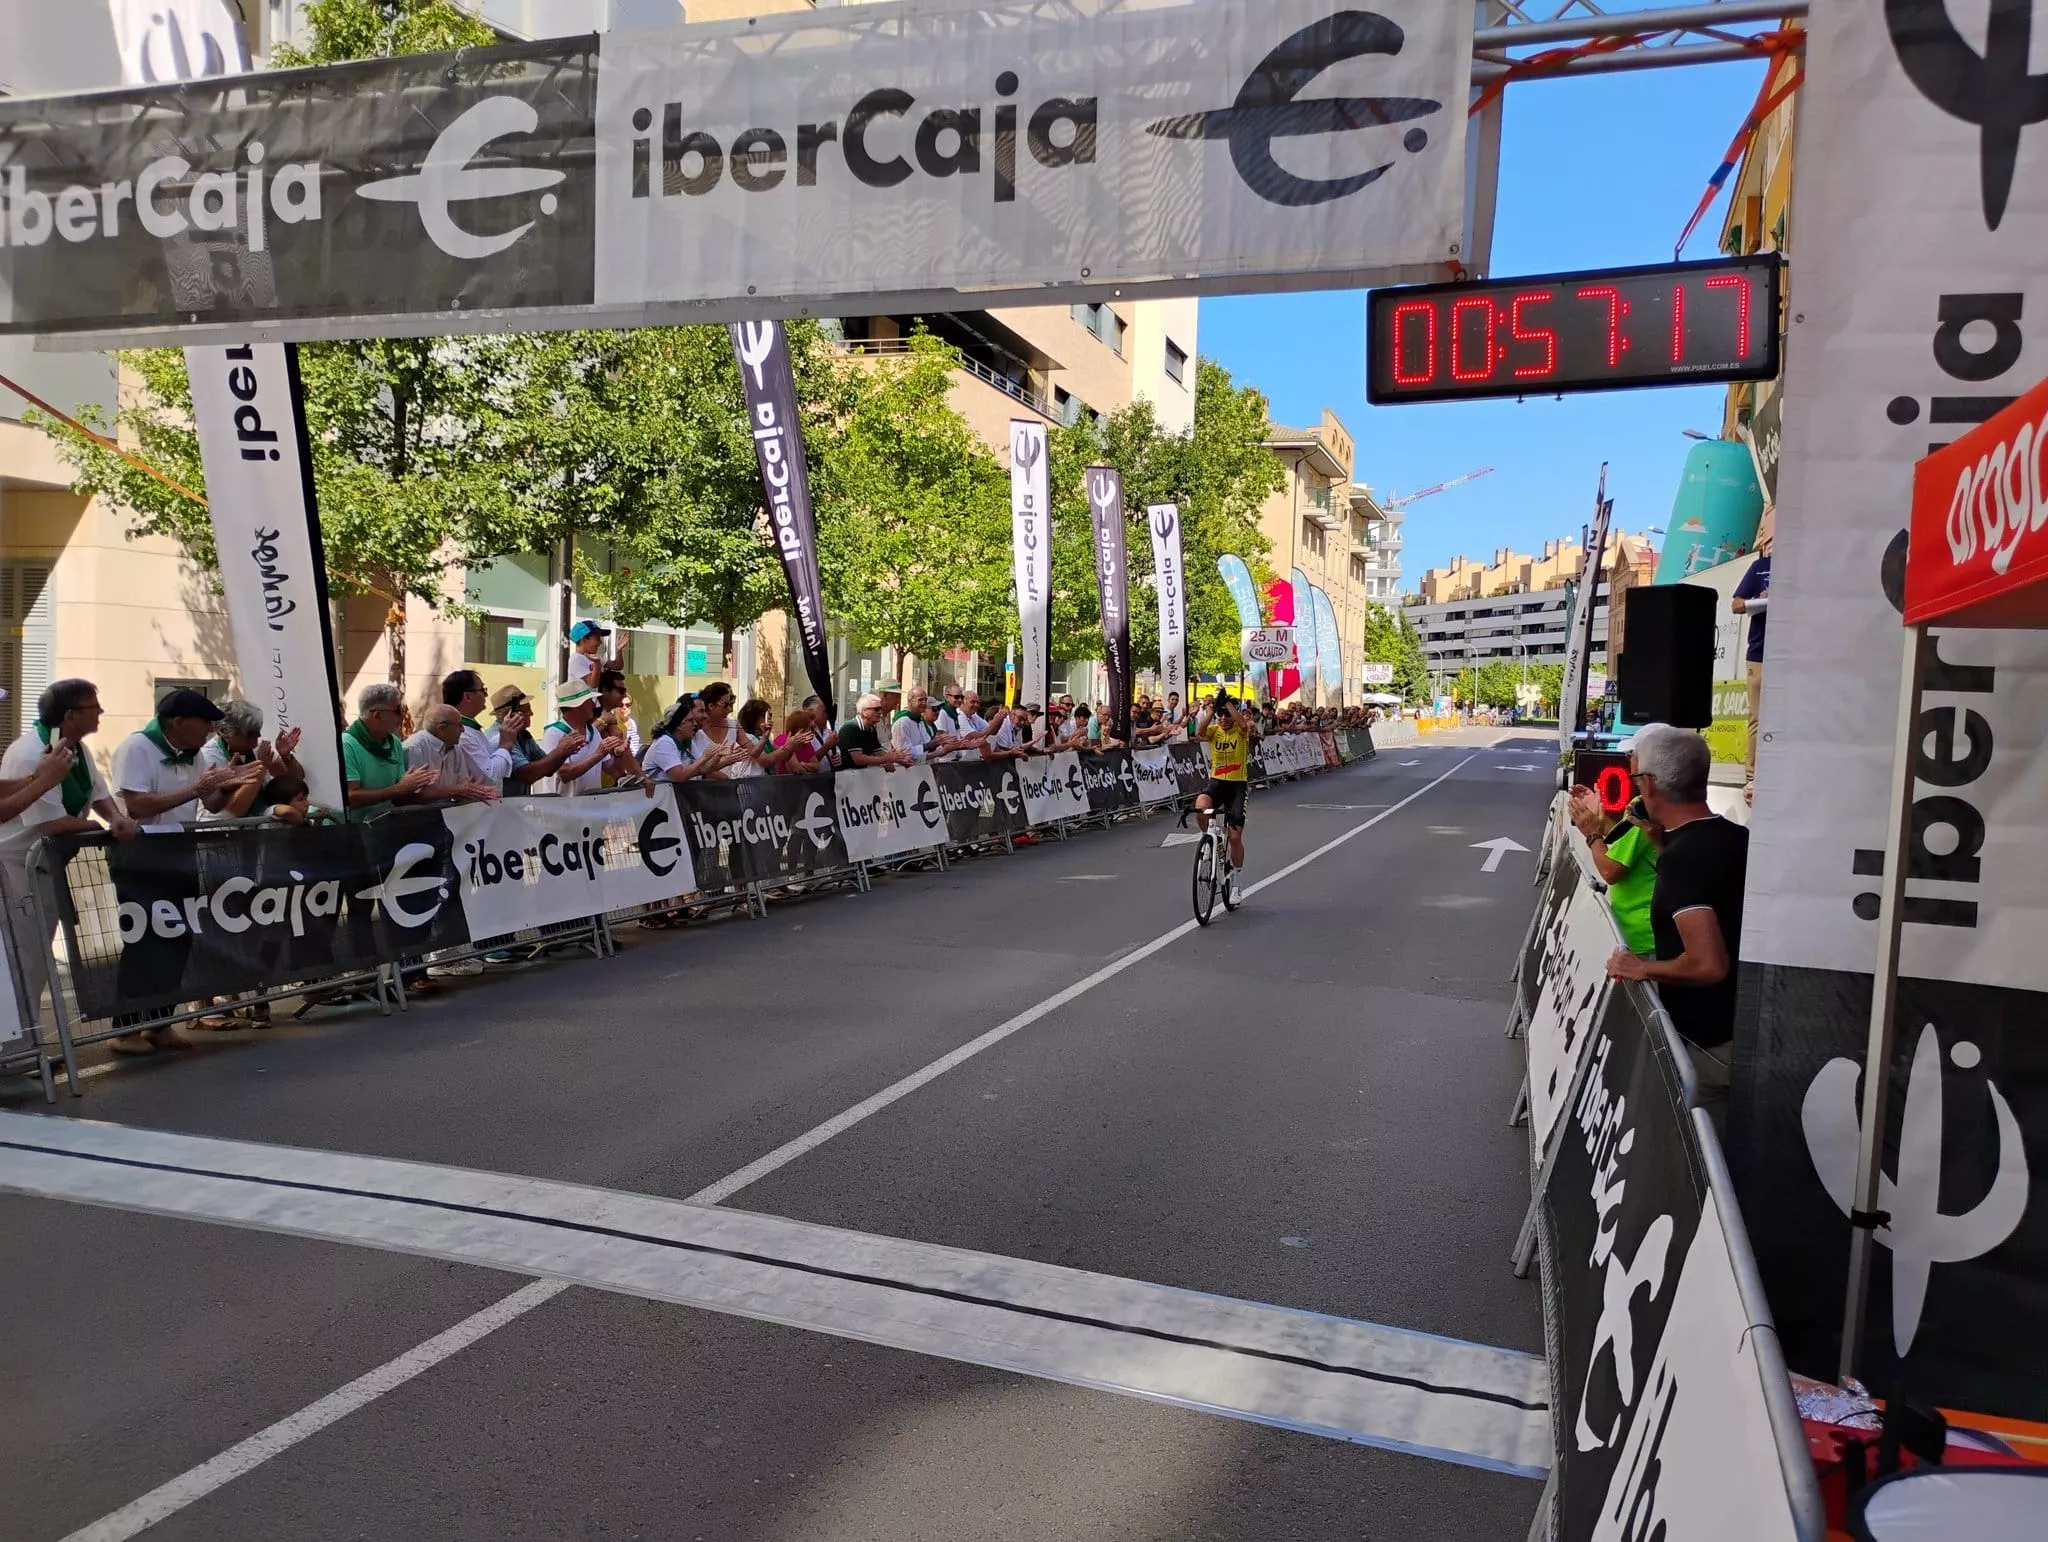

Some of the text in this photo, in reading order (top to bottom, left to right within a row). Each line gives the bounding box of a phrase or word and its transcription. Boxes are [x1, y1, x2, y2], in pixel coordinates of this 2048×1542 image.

[632, 70, 1098, 204] iberCaja
[1393, 275, 1750, 384] 00:57:17
[1670, 361, 1741, 373] WWW.PIXELCOM.ES
[1276, 630, 1288, 641] M
[1214, 740, 1238, 751] UPV
[940, 781, 994, 812] iberCaja
[1084, 766, 1117, 791] iberCaja
[1599, 767, 1631, 811] 0
[693, 804, 790, 850] iberCaja
[841, 792, 907, 829] iberCaja
[464, 826, 606, 888] iberCaja
[117, 870, 341, 945] berCaja
